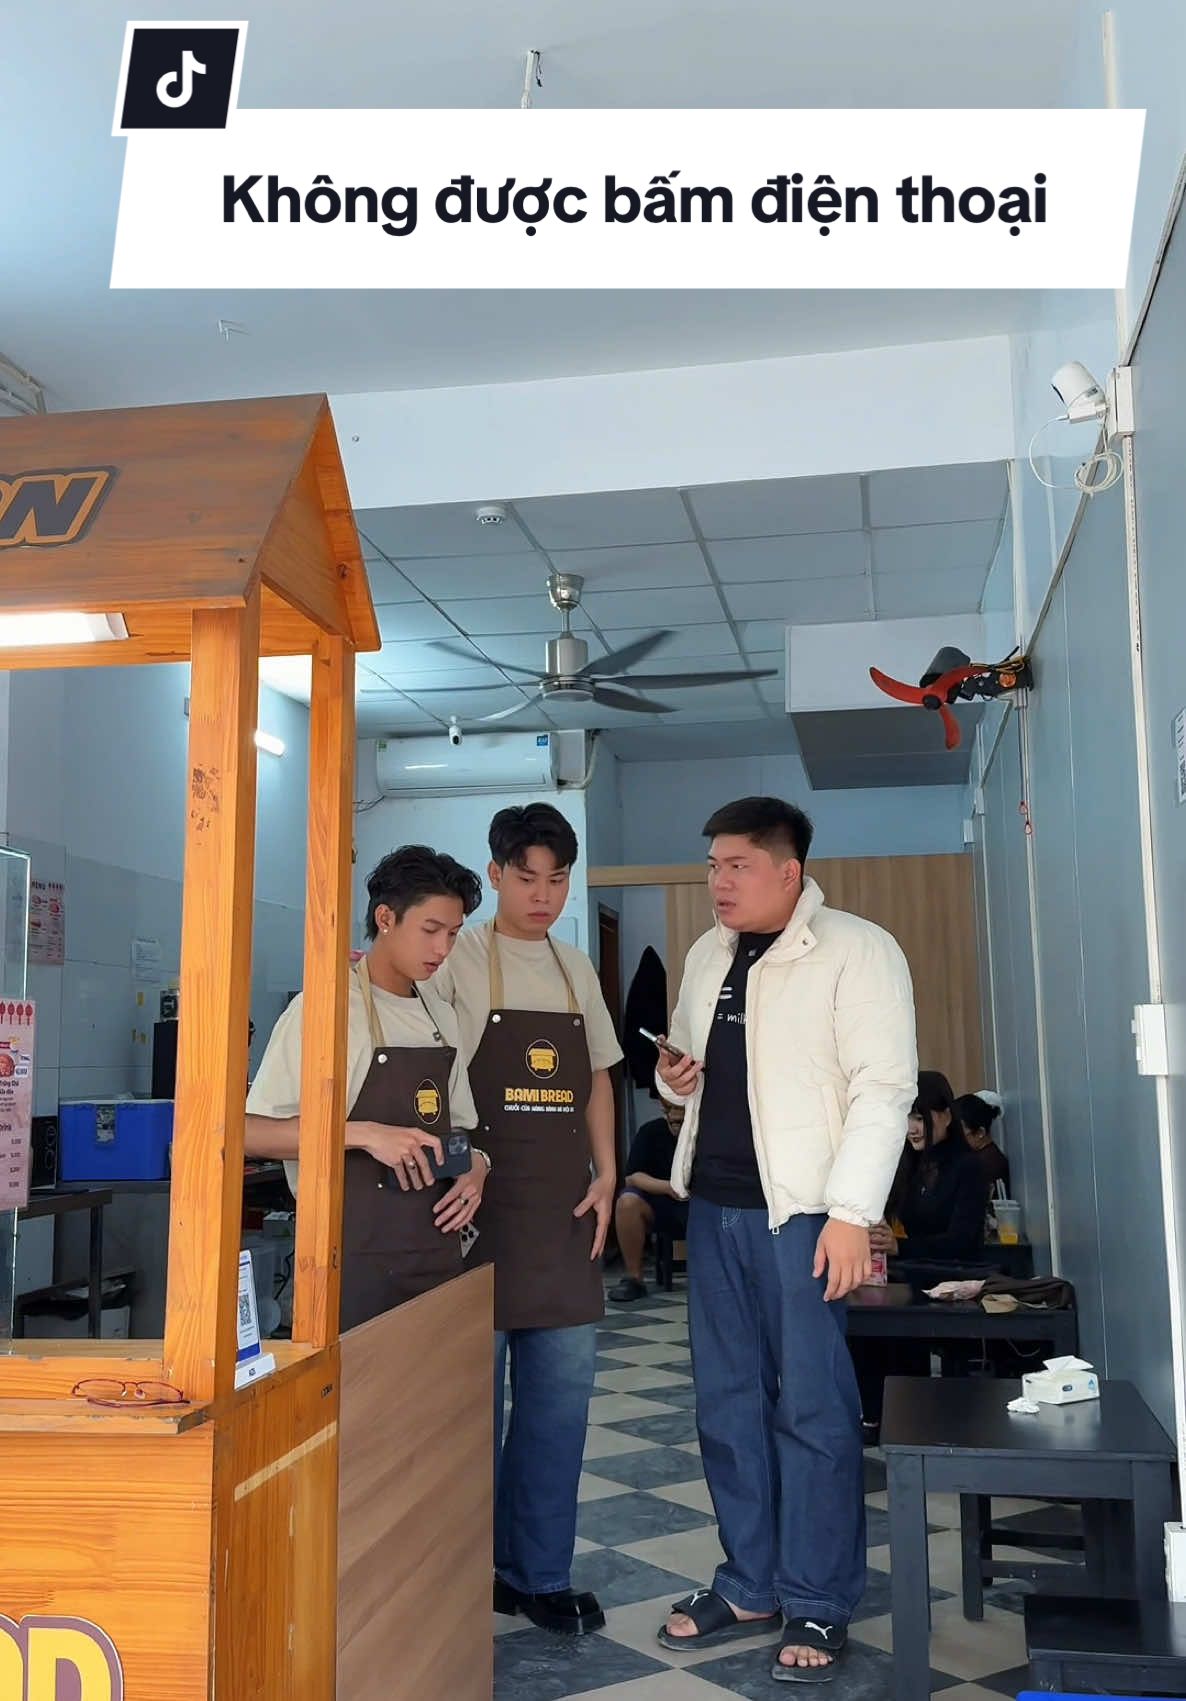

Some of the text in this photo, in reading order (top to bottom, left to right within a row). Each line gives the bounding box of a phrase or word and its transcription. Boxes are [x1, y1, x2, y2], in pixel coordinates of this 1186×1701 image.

[0, 472, 106, 546] N
[504, 1087, 574, 1103] BAMI BREAD
